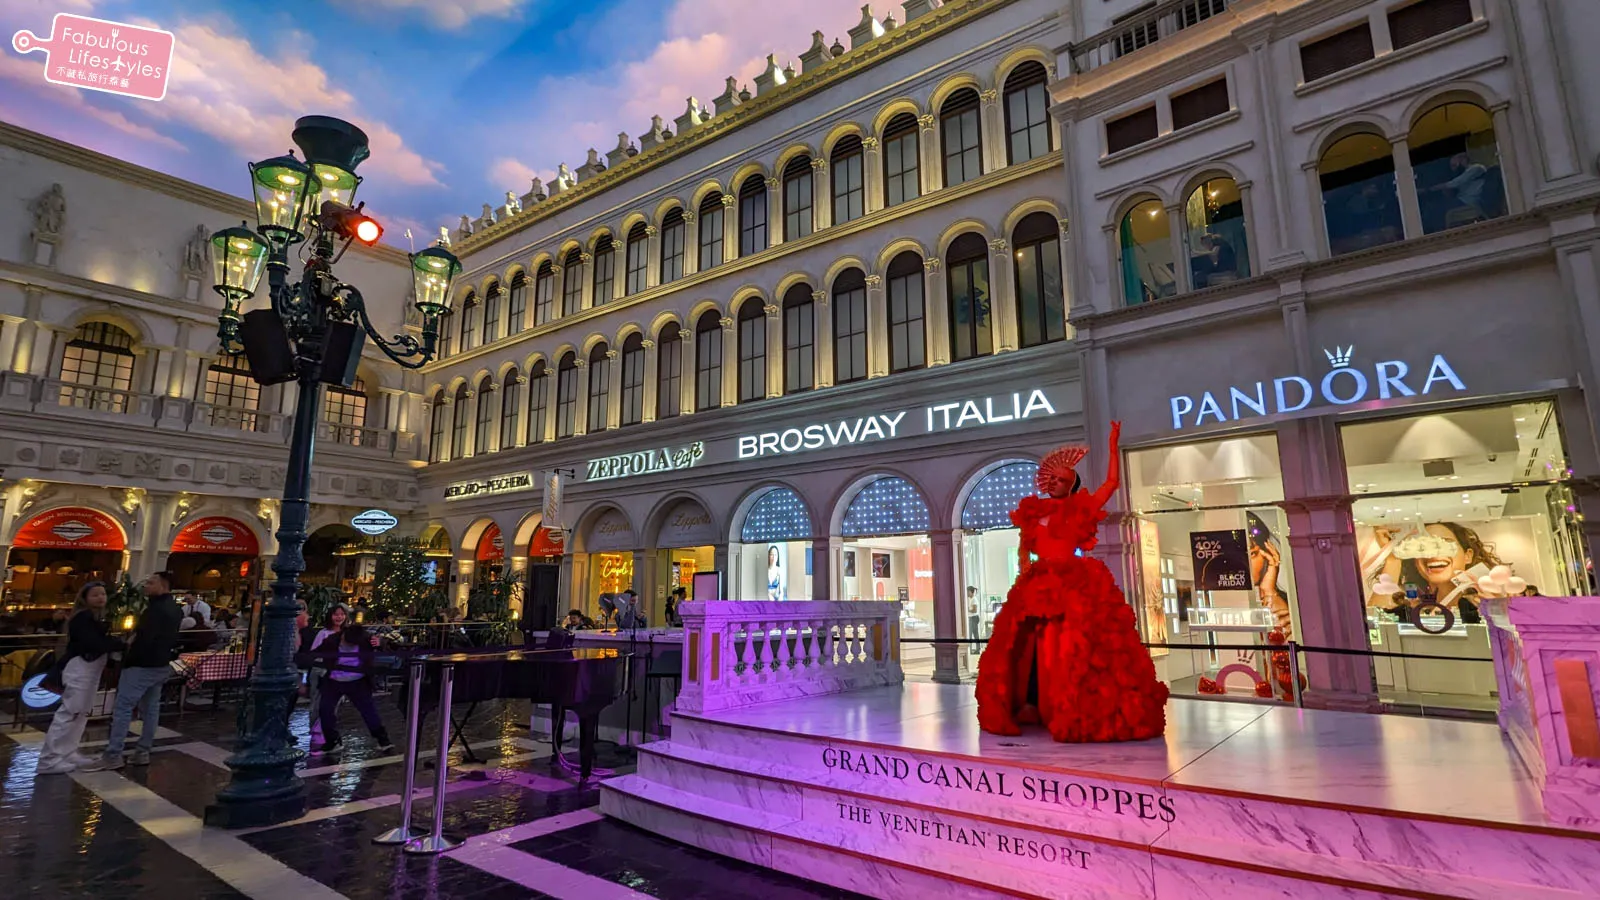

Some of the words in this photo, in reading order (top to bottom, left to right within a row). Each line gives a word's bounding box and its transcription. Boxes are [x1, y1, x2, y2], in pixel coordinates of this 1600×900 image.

[1169, 353, 1467, 430] PANDORA
[737, 410, 907, 459] BROSWAY
[927, 388, 1056, 432] ITALIA
[586, 448, 670, 480] ZEPPOLA
[671, 441, 704, 468] Café
[1195, 540, 1221, 550] 40%
[1196, 550, 1218, 559] OFF
[1219, 573, 1245, 581] BLACK
[822, 747, 909, 780] GRAND
[917, 761, 1014, 797] CANAL
[1022, 776, 1177, 823] SHOPPES
[836, 802, 872, 825] THE
[997, 834, 1091, 870] RESORT
